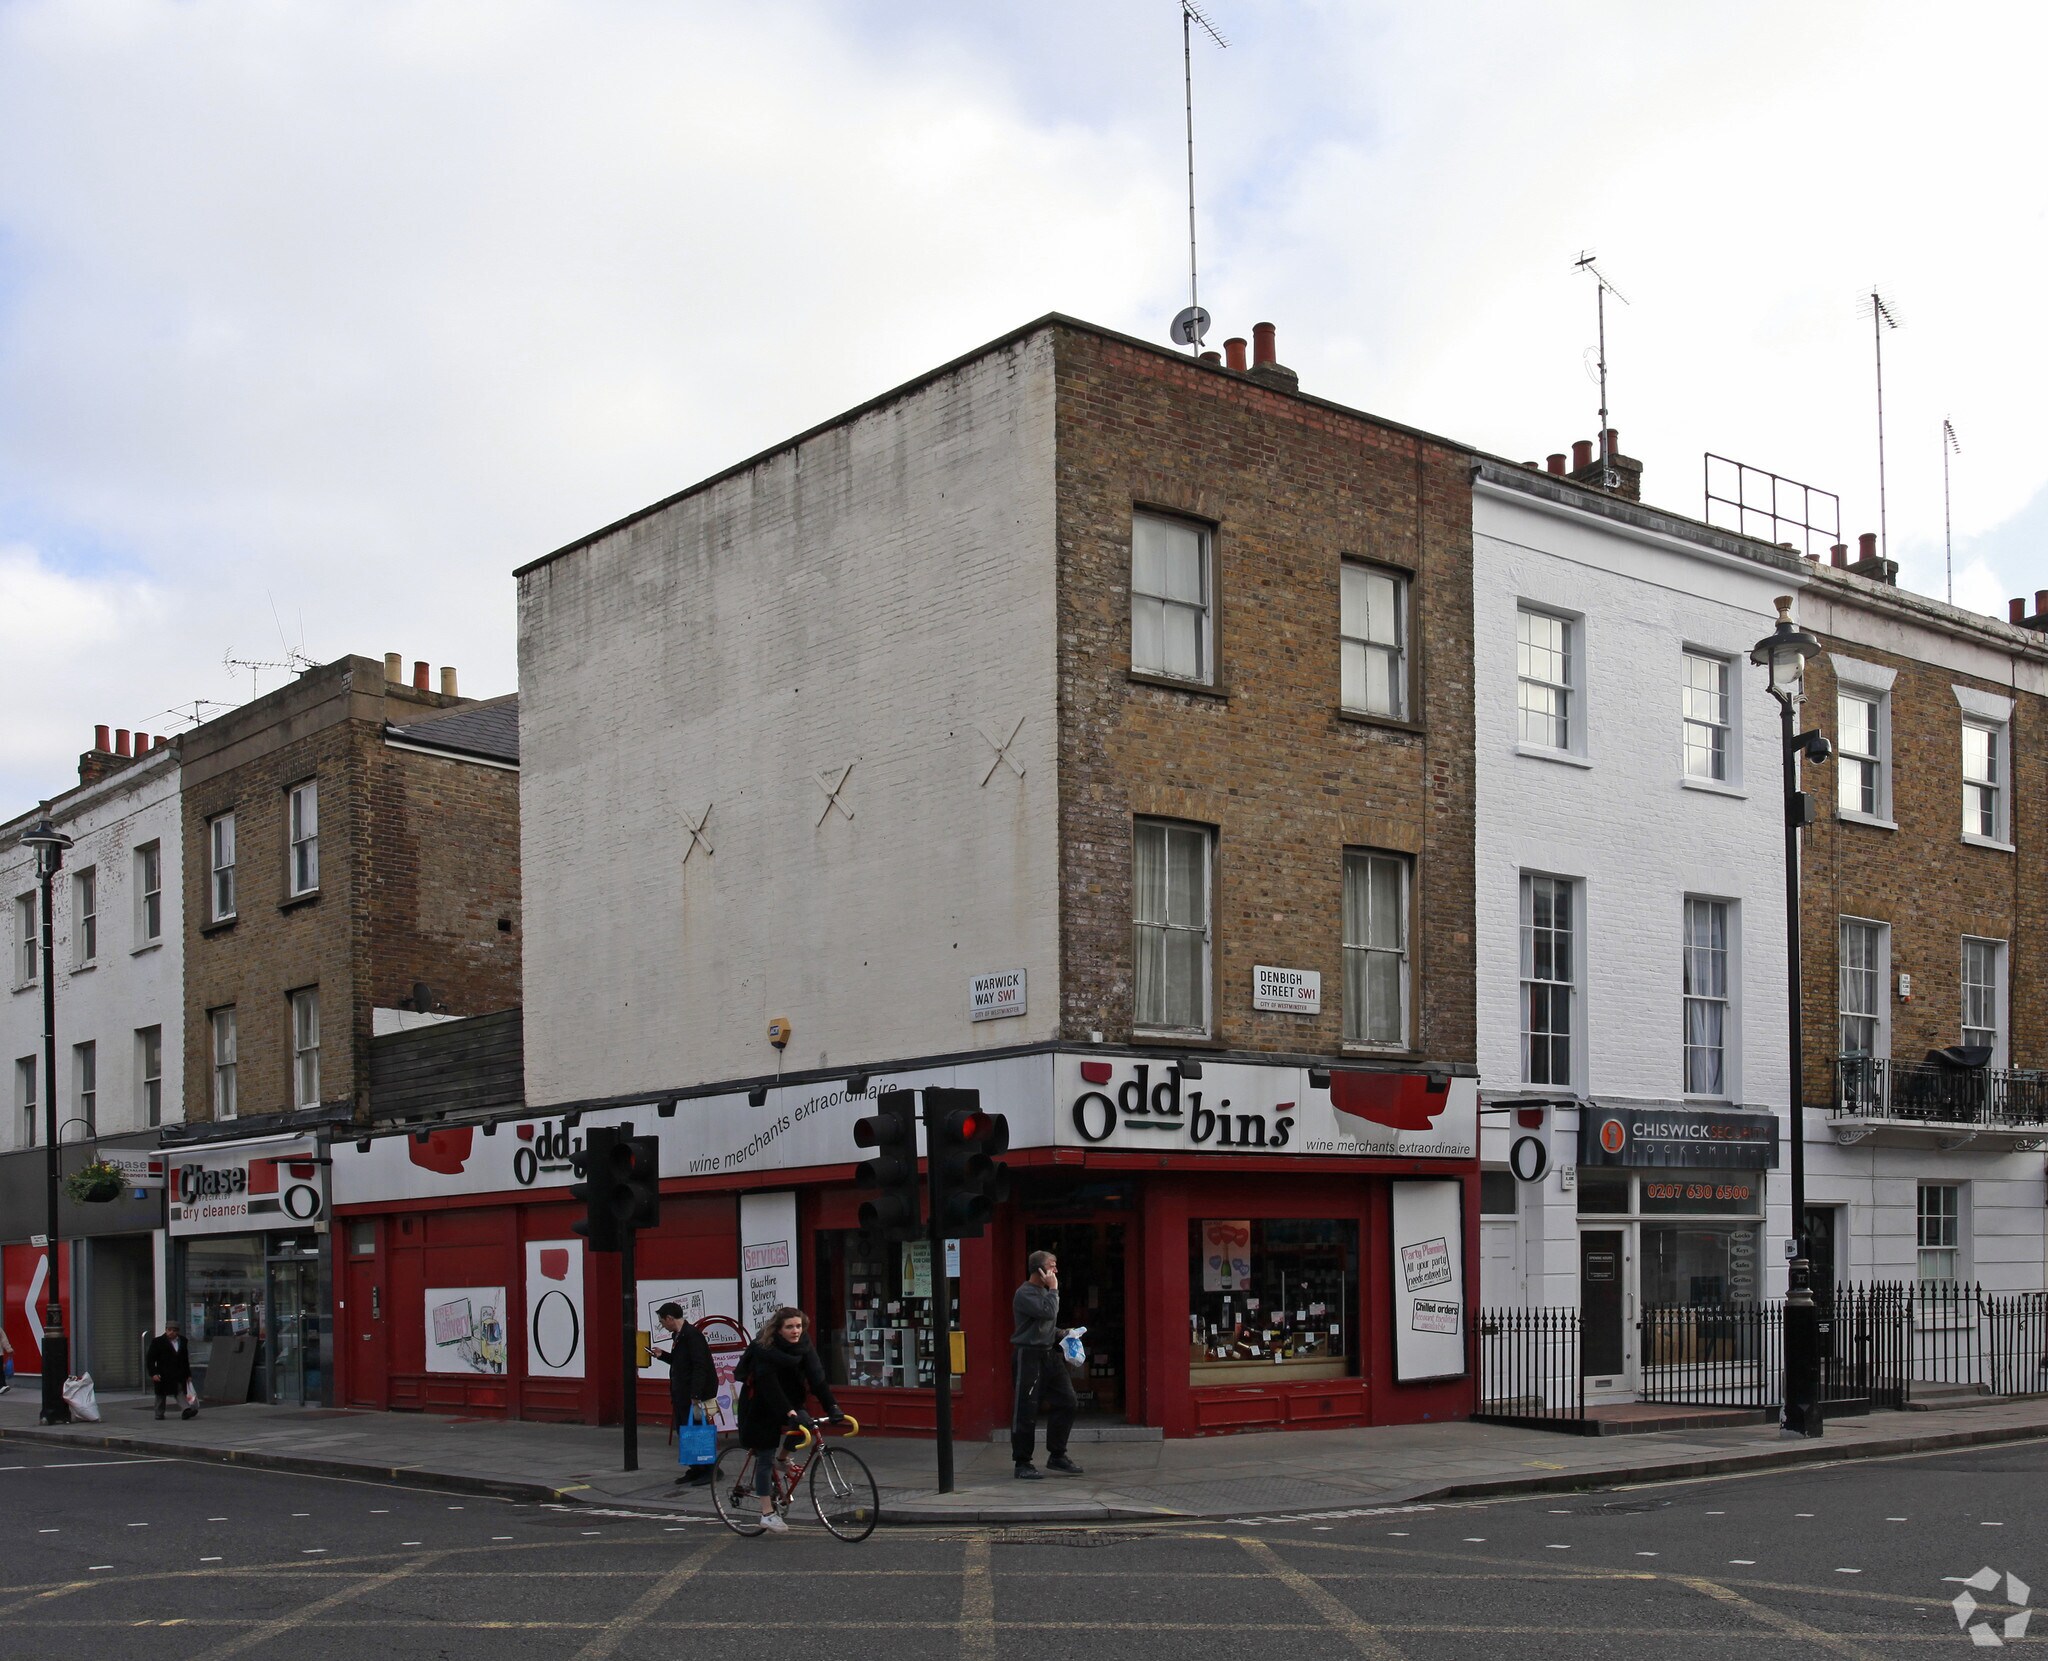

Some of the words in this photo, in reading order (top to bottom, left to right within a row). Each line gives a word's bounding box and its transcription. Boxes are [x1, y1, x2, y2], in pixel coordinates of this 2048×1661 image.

[974, 974, 1019, 991] WARWICK
[1260, 970, 1302, 985] DENBIGH
[974, 992, 995, 1006] WAY
[997, 989, 1016, 1002] SW1
[1260, 984, 1294, 997] STREET
[1298, 987, 1316, 999] SW1
[1632, 1122, 1710, 1138] CHISWICK
[1711, 1125, 1771, 1140] SECURITY
[688, 1153, 720, 1173] wine
[724, 1115, 791, 1169] merchants
[1306, 1138, 1334, 1151] wine
[1337, 1139, 1396, 1154] merchants
[1398, 1141, 1471, 1155] extraordinaire
[178, 1163, 247, 1204] Chase
[1647, 1183, 1683, 1198] 0207
[1686, 1184, 1713, 1199] 630
[1715, 1185, 1750, 1200] 6500
[183, 1207, 200, 1222] dry
[202, 1204, 247, 1218] cleaners
[745, 1245, 787, 1269] Services
[1403, 1247, 1422, 1261] Party
[1736, 1247, 1749, 1256] Keys
[1406, 1262, 1414, 1273] All
[1416, 1260, 1429, 1274] your
[1431, 1256, 1447, 1269] party
[750, 1277, 764, 1288] Glass
[764, 1275, 777, 1286] Hire
[751, 1289, 777, 1302] Delivery
[1415, 1301, 1436, 1313] Chilled
[1437, 1304, 1459, 1315] orders
